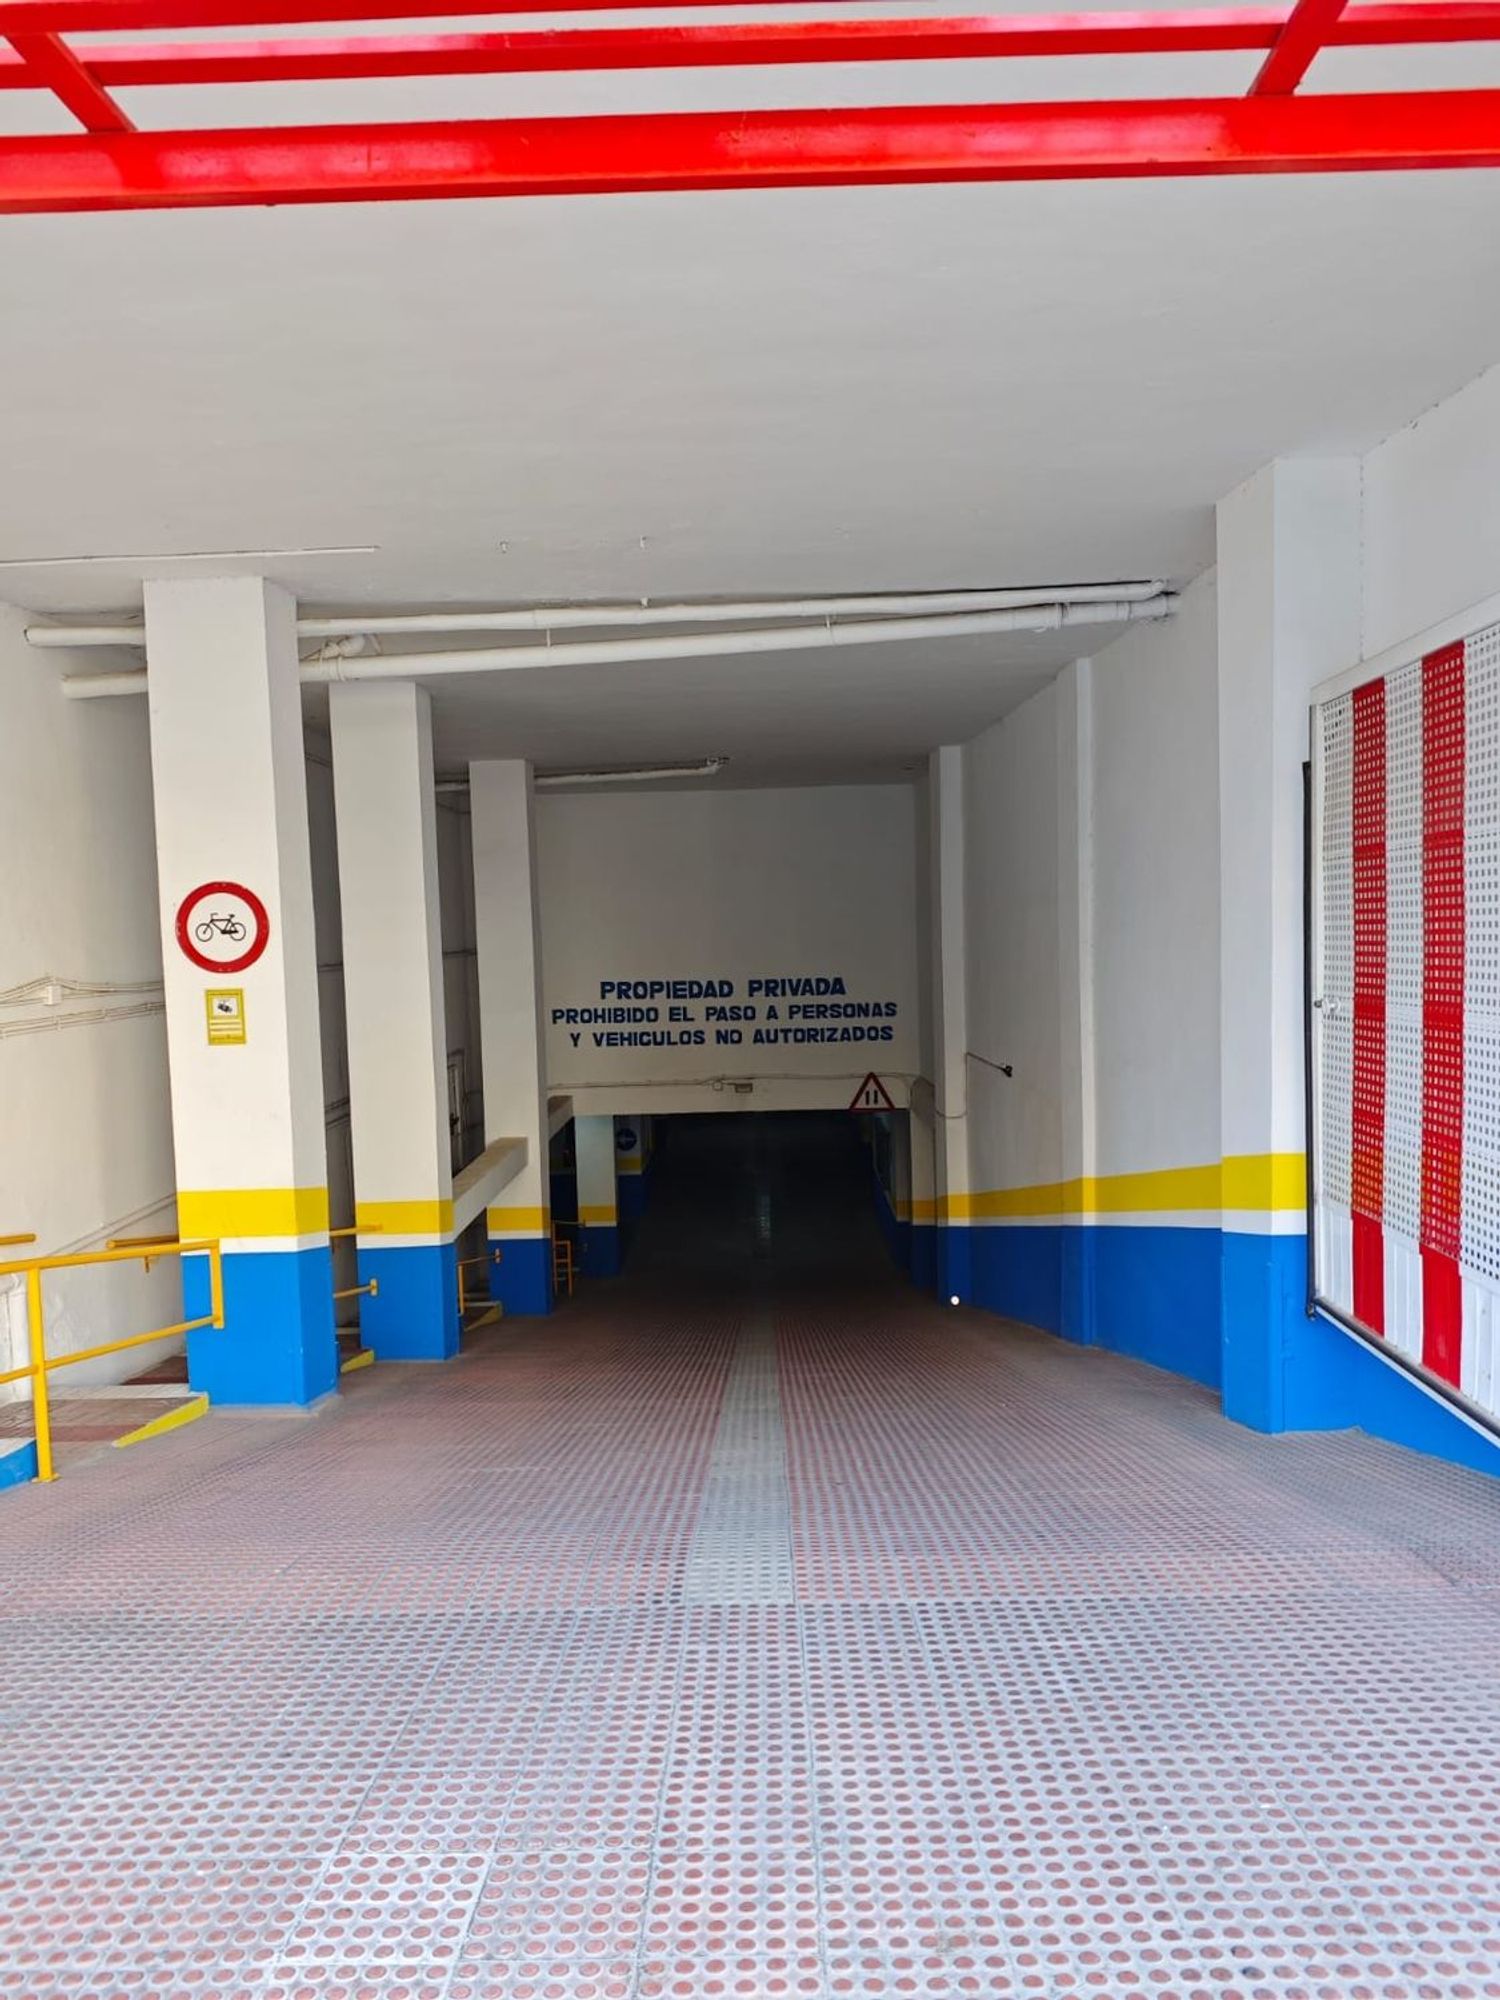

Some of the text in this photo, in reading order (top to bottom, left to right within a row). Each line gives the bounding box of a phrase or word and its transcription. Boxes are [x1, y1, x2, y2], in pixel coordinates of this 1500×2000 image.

[600, 977, 846, 999] PROPIEDAD PRIVADA
[552, 1002, 897, 1024] PROHIBIDO EL PASO A PERSONAS
[570, 1026, 893, 1047] Y VEHICULOS NO AUTORIZADOS
